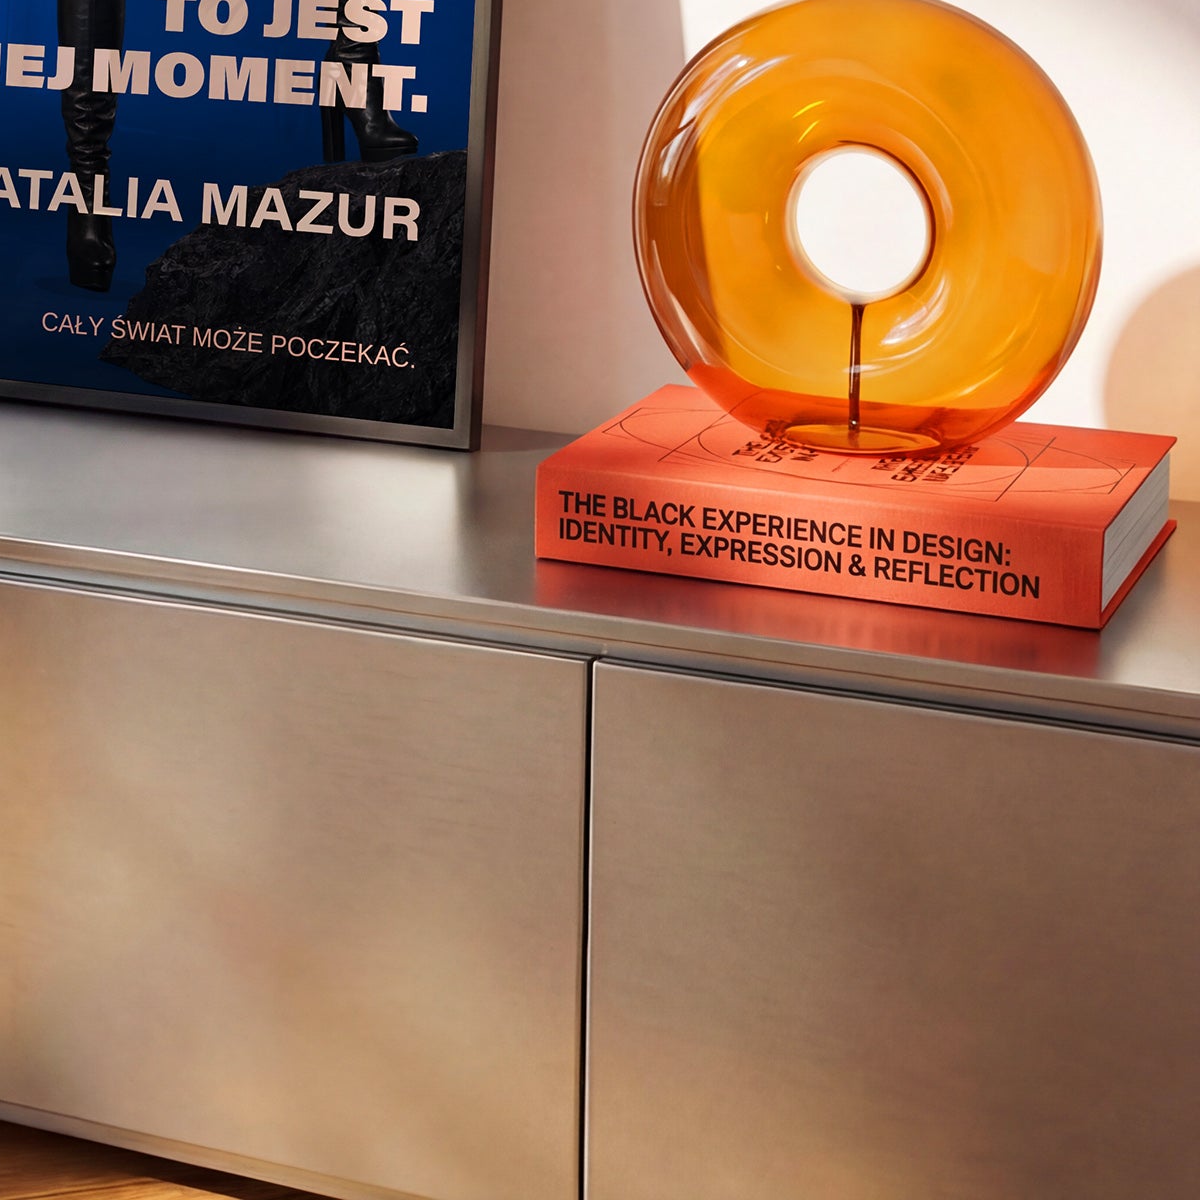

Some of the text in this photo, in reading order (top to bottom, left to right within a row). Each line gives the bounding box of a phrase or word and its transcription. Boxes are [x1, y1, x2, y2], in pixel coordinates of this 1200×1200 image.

[91, 47, 429, 113] MOMENT.
[201, 182, 422, 242] MAZUR
[41, 311, 416, 369] CAŁY ŚWIAT MOŻE POCZEKAĆ.
[558, 489, 1012, 567] THE BLACK EXPERIENCE IN DESIGN:
[559, 517, 1040, 600] IDENTITY, EXPRESSION & REFLECTION
